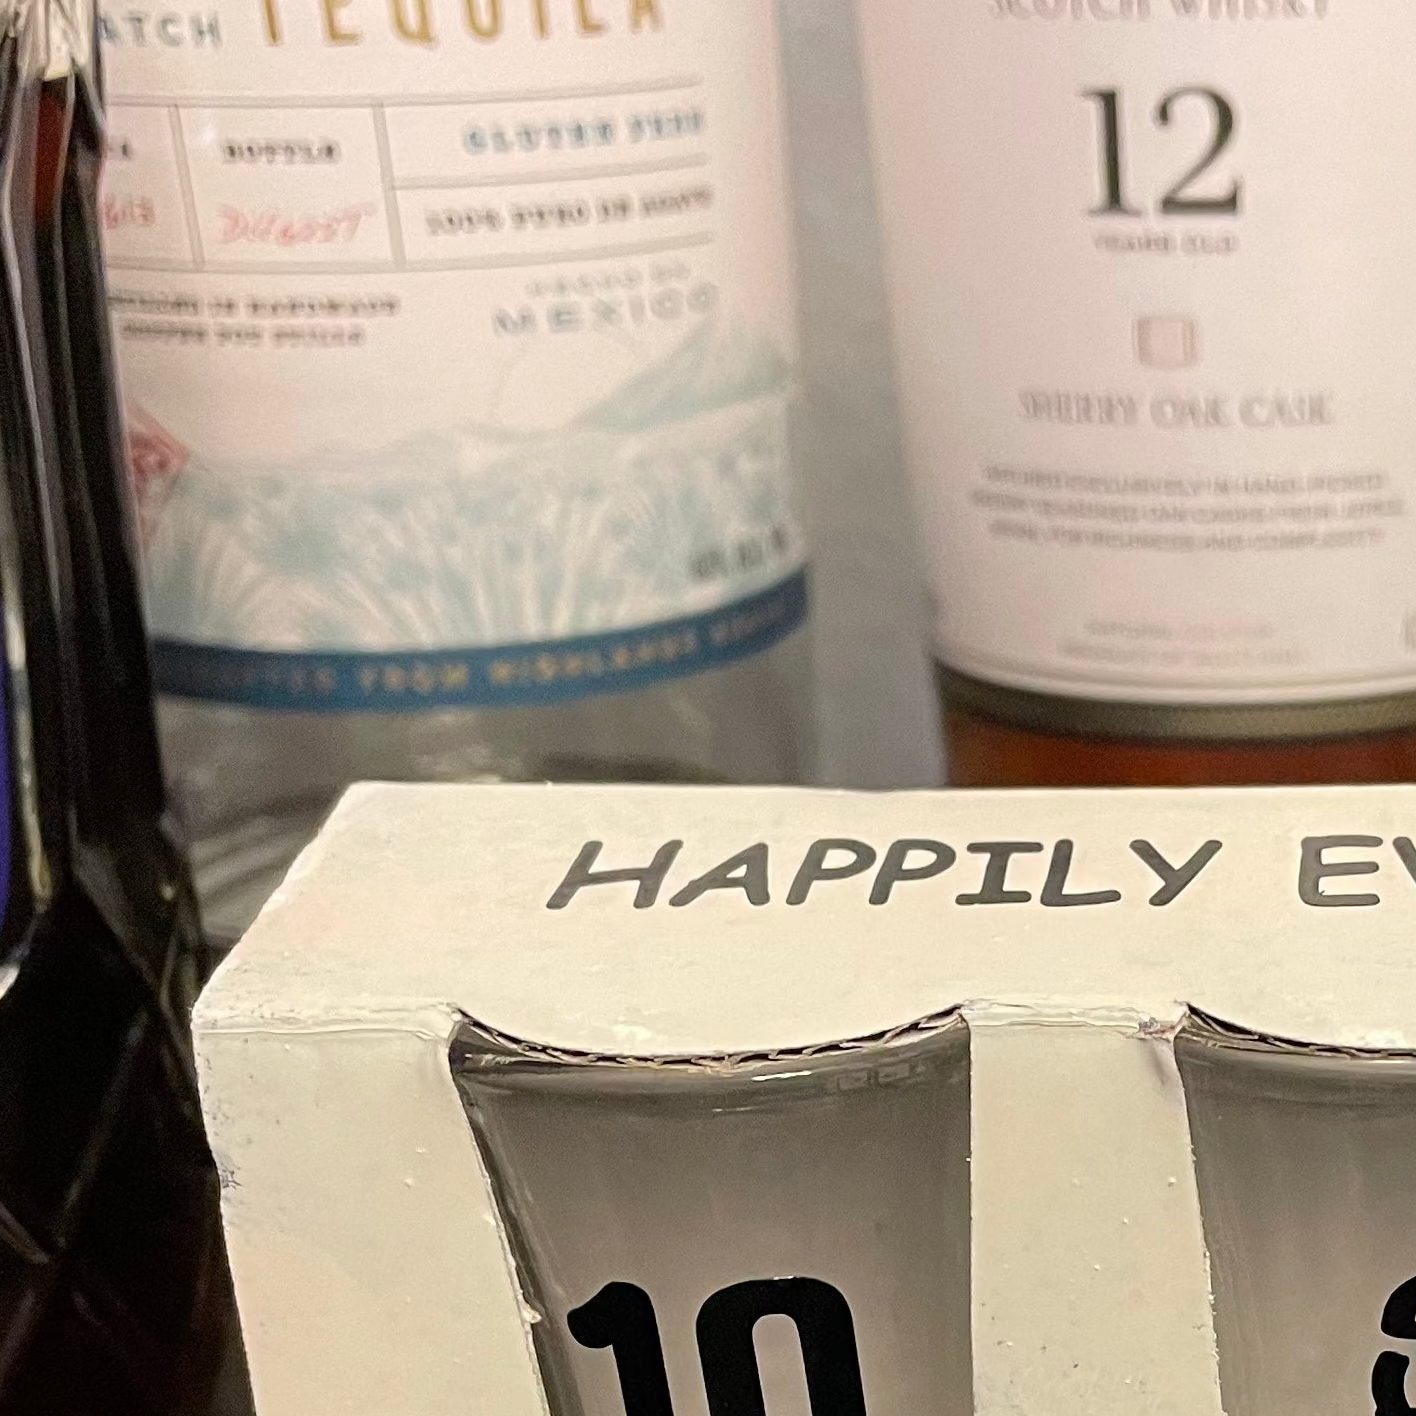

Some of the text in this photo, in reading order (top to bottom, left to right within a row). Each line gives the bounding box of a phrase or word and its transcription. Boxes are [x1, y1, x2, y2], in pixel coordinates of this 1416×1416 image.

[99, 10, 222, 47] ATCH
[1076, 84, 1242, 217] 12
[546, 838, 1222, 909] HAPPILY
